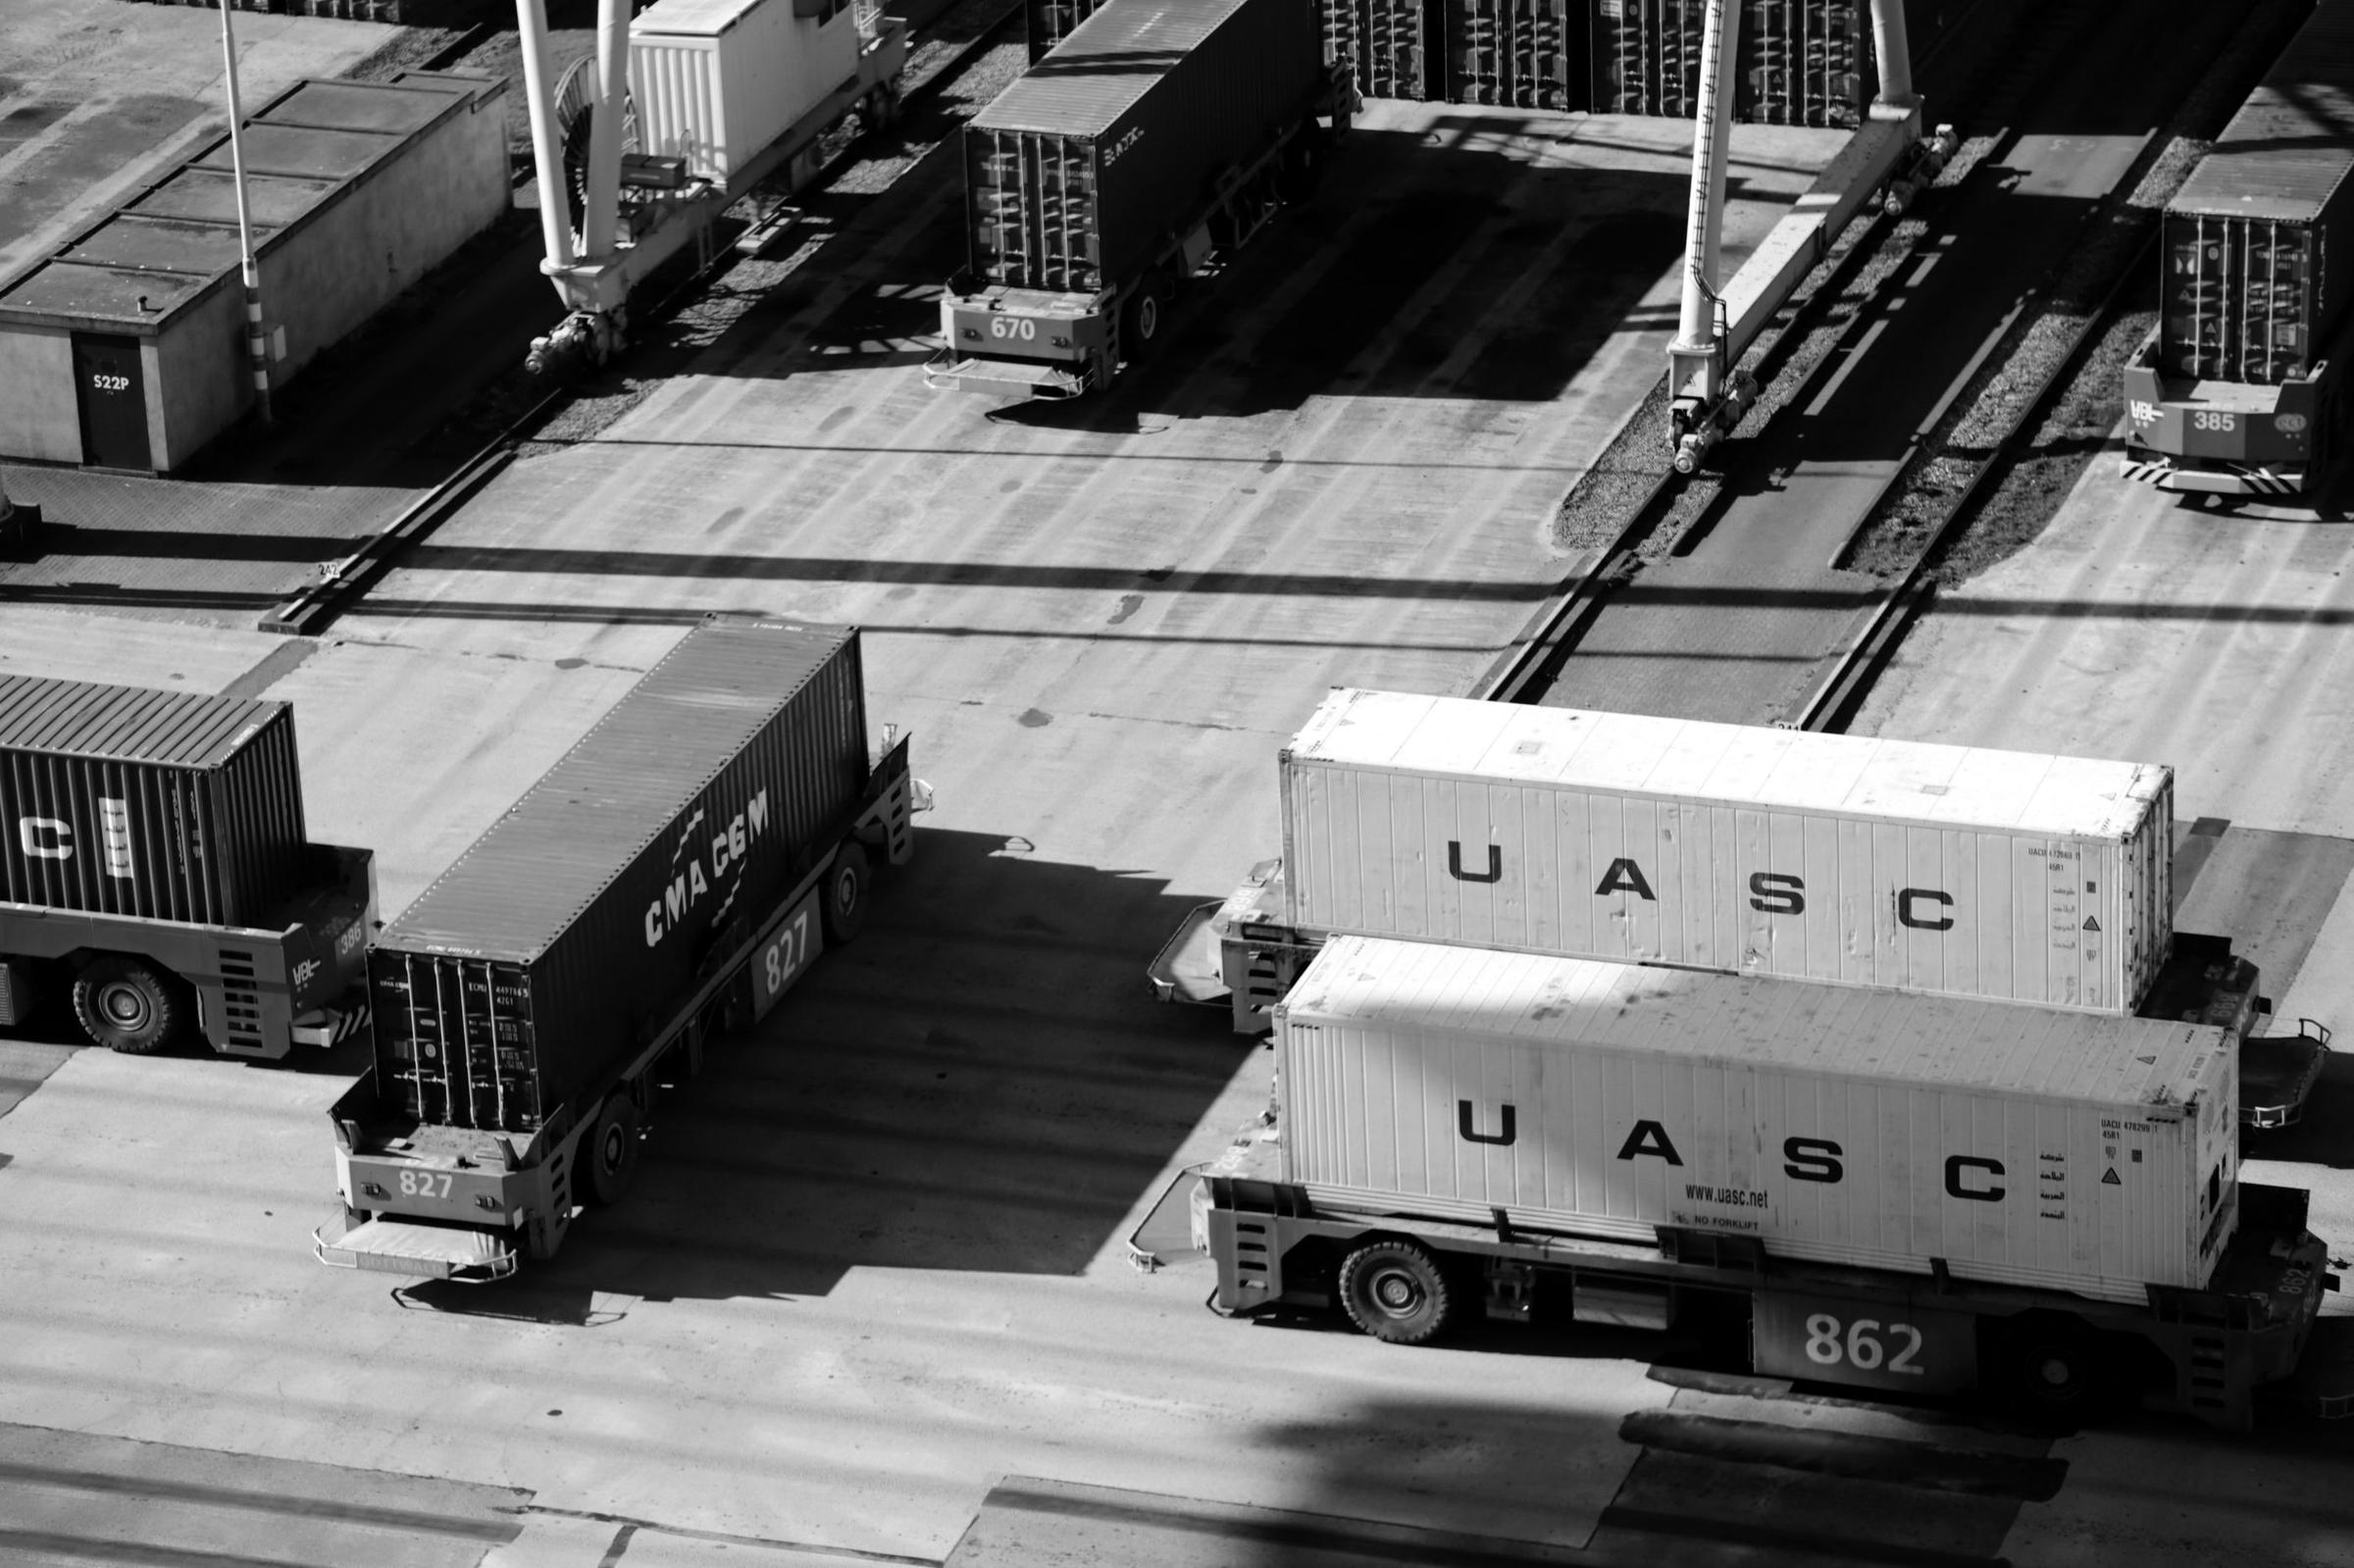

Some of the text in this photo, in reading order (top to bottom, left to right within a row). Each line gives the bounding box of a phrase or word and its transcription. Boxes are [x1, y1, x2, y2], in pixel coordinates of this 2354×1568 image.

[991, 317, 1036, 340] 670
[93, 374, 129, 391] S22P
[2194, 411, 2235, 431] 385
[20, 816, 74, 860] C
[644, 787, 769, 948] CMA CGM
[340, 921, 362, 955] 386
[765, 910, 809, 995] 827
[2101, 1119, 2121, 1129] UACU
[399, 1170, 453, 1198] 827
[1685, 1184, 1768, 1208] www.uasc.net
[1694, 1215, 1710, 1225] NO
[1713, 1216, 1759, 1231] FORKLIFT
[2277, 1264, 2313, 1295] 862
[1805, 1312, 1924, 1376] 862
